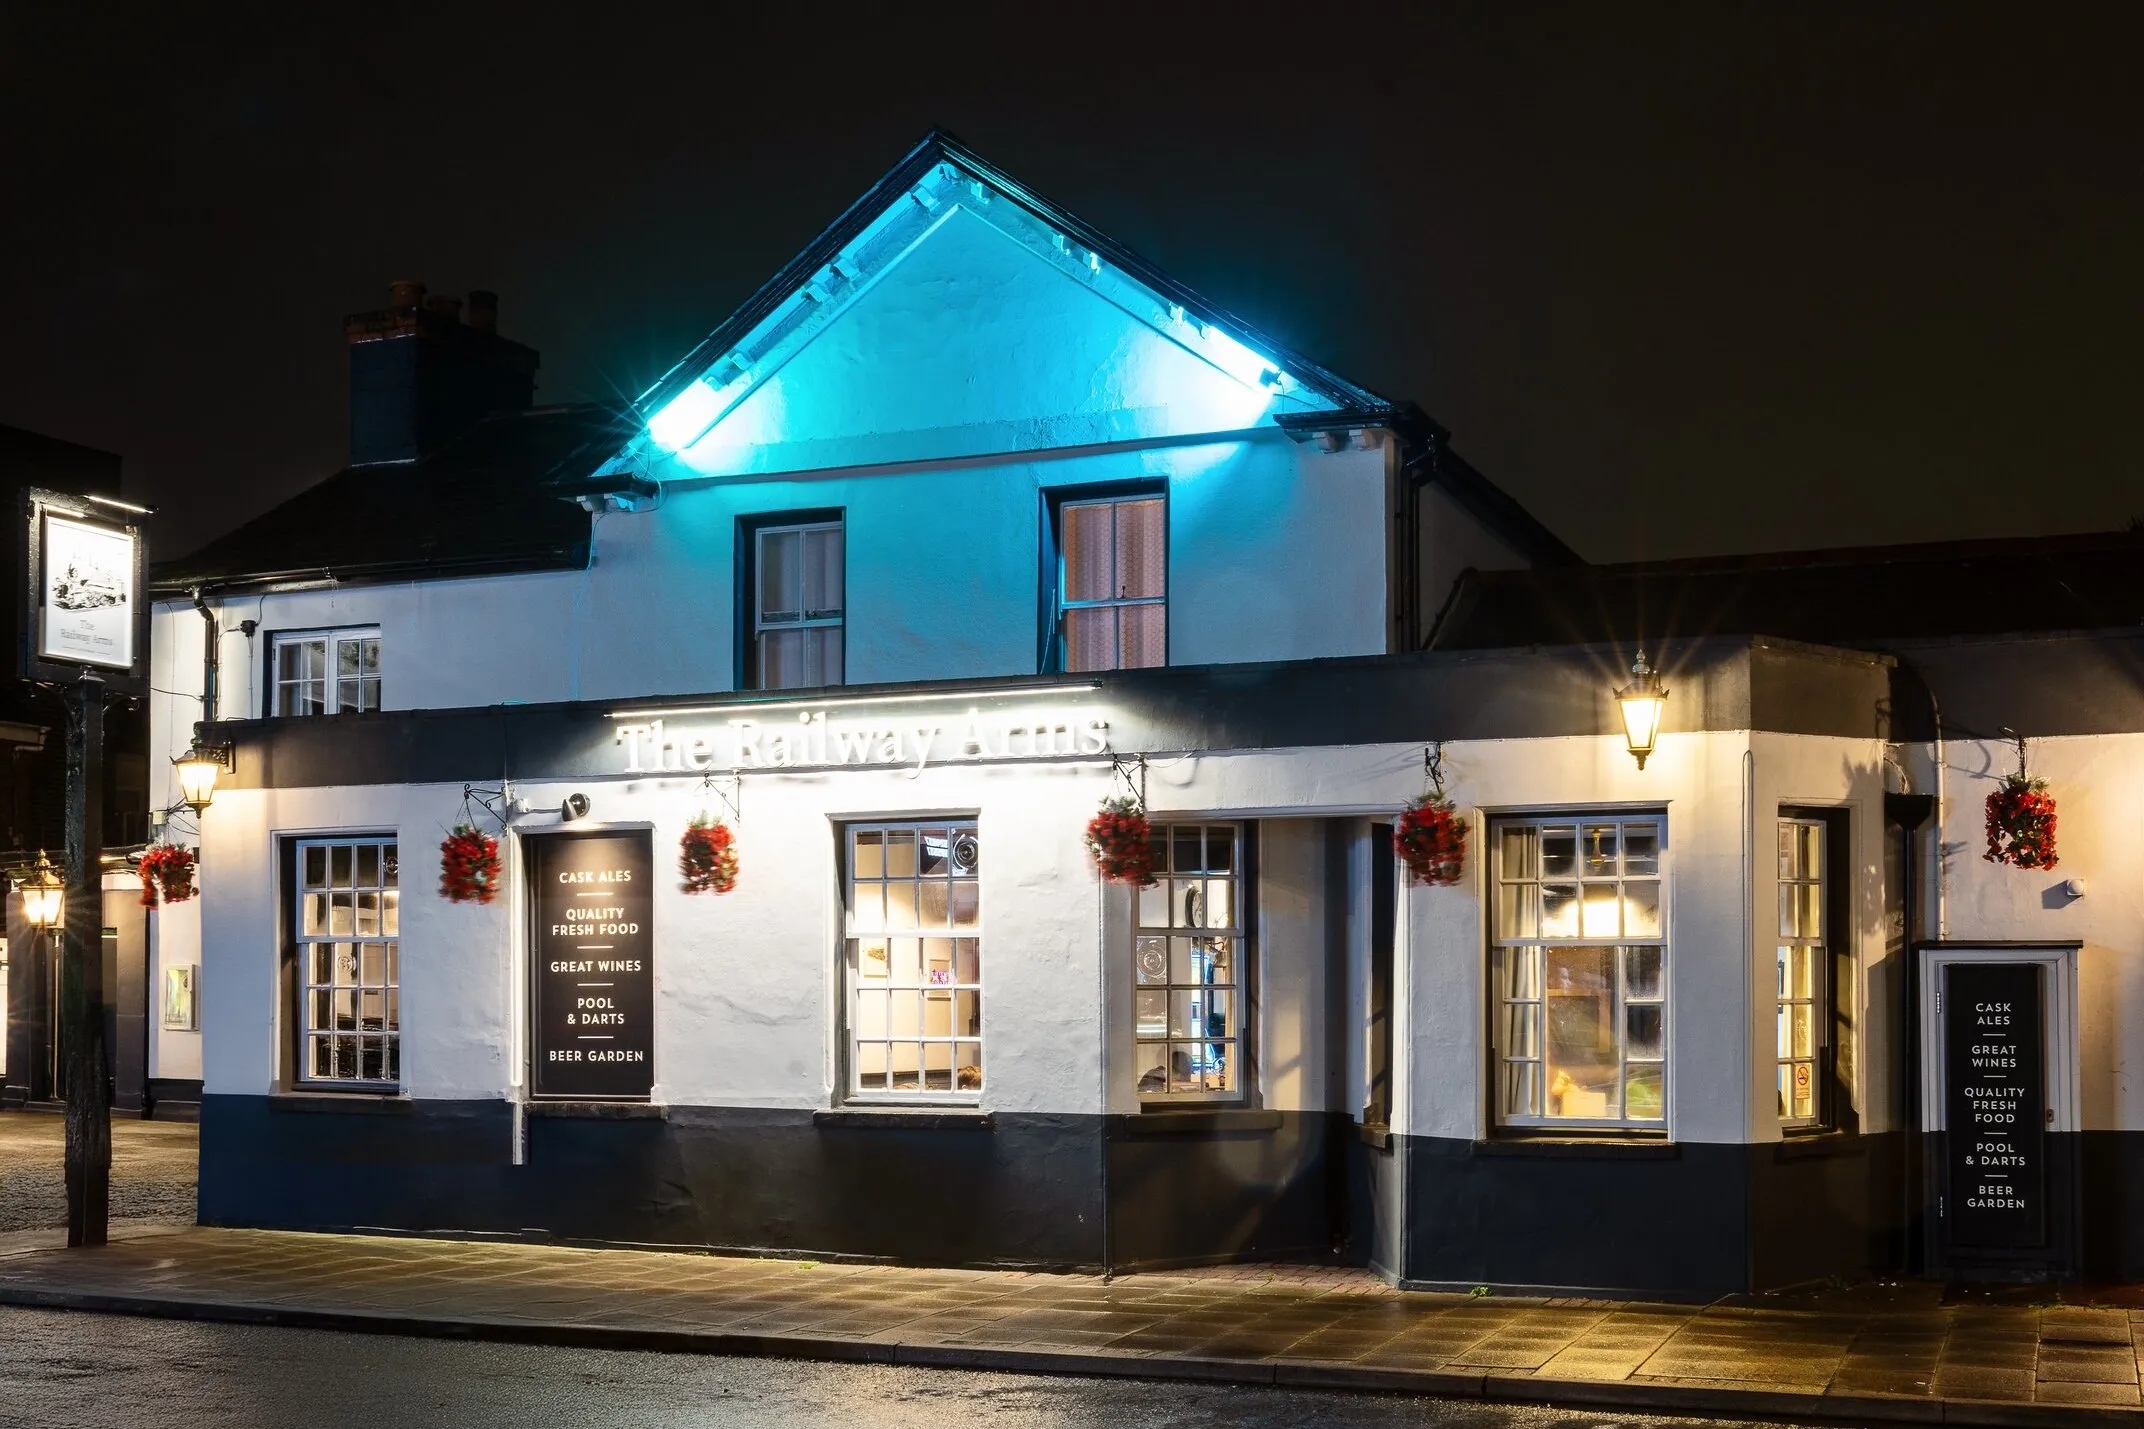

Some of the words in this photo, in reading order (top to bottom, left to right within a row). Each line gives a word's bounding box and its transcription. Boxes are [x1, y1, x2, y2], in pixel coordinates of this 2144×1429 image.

[616, 720, 712, 774] The
[728, 711, 941, 779] Railway
[948, 707, 1109, 761] Arms
[559, 870, 594, 884] CASK
[598, 869, 632, 883] ALES
[565, 907, 625, 921] QUALITY
[552, 924, 595, 936] FRESH
[599, 922, 639, 935] FOOD
[550, 960, 594, 973] GREAT
[597, 959, 641, 972] WINES
[577, 997, 615, 1009] POOL
[1975, 1002, 2012, 1013] CASK
[567, 1013, 576, 1025] &
[581, 1013, 625, 1025] DARTS
[1976, 1015, 2010, 1026] ALES
[1971, 1045, 2017, 1055] GREAT
[549, 1050, 582, 1062] BEER
[587, 1050, 643, 1062] GARDEN
[1971, 1058, 2017, 1068] WINES
[1964, 1087, 2025, 1098] QUALITY
[1973, 1100, 2016, 1110] FRESH
[1975, 1113, 2015, 1123] FOOD
[1976, 1142, 2015, 1153] POOL
[1965, 1155, 1975, 1166] &
[1981, 1155, 2026, 1166] DARTS
[1978, 1185, 2013, 1196] BEER
[1966, 1198, 2025, 1209] GARDEN
